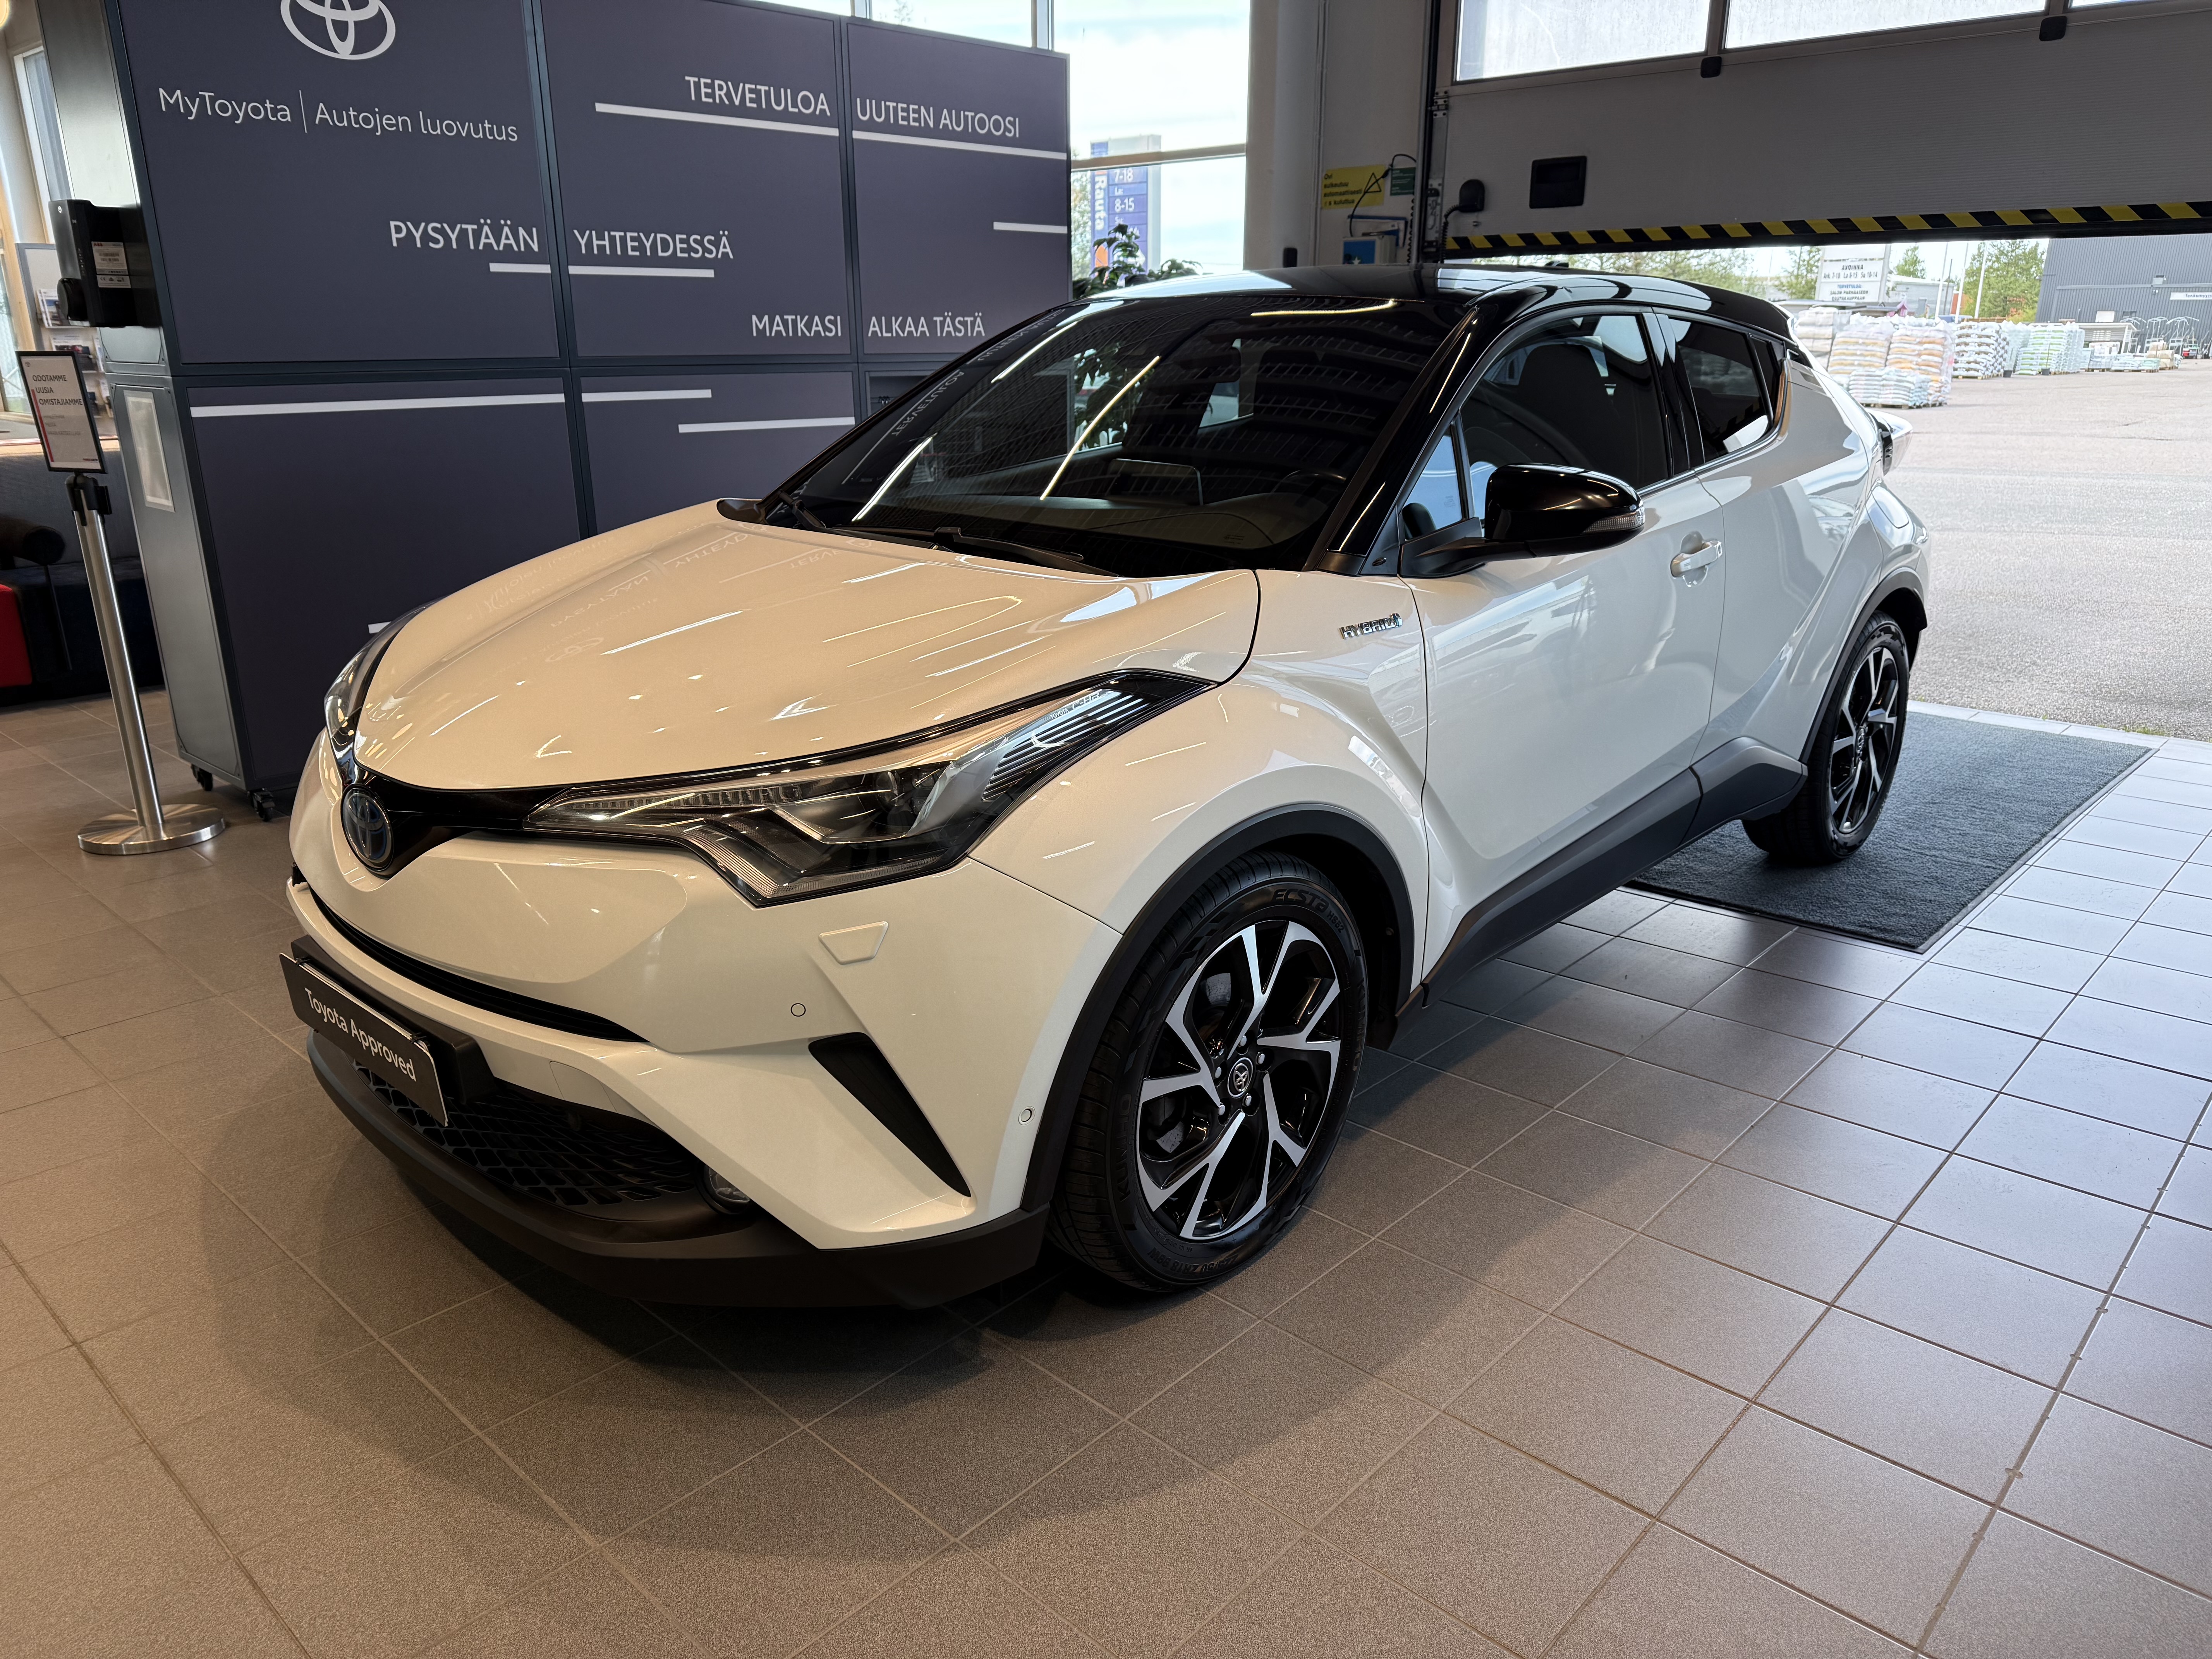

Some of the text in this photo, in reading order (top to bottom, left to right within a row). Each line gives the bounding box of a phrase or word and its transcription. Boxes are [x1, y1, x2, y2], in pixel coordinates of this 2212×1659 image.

[159, 88, 518, 141] MyToyota Autojen luovutus
[685, 76, 1020, 137] TERVETULOA UUTEEN AUTOOSI
[1095, 175, 1108, 230] Rauta
[1115, 198, 1135, 213] 8-15
[389, 218, 734, 259] PYSYTÄÄN YHTEYDESSÄ
[751, 312, 986, 337] MATKASI ALKAA TÄSTÄ
[1339, 617, 1396, 639] HYBRID
[1049, 708, 1070, 720] TOYOTA
[1072, 692, 1100, 710] C-HR
[304, 987, 416, 1082] Toyota Approved
